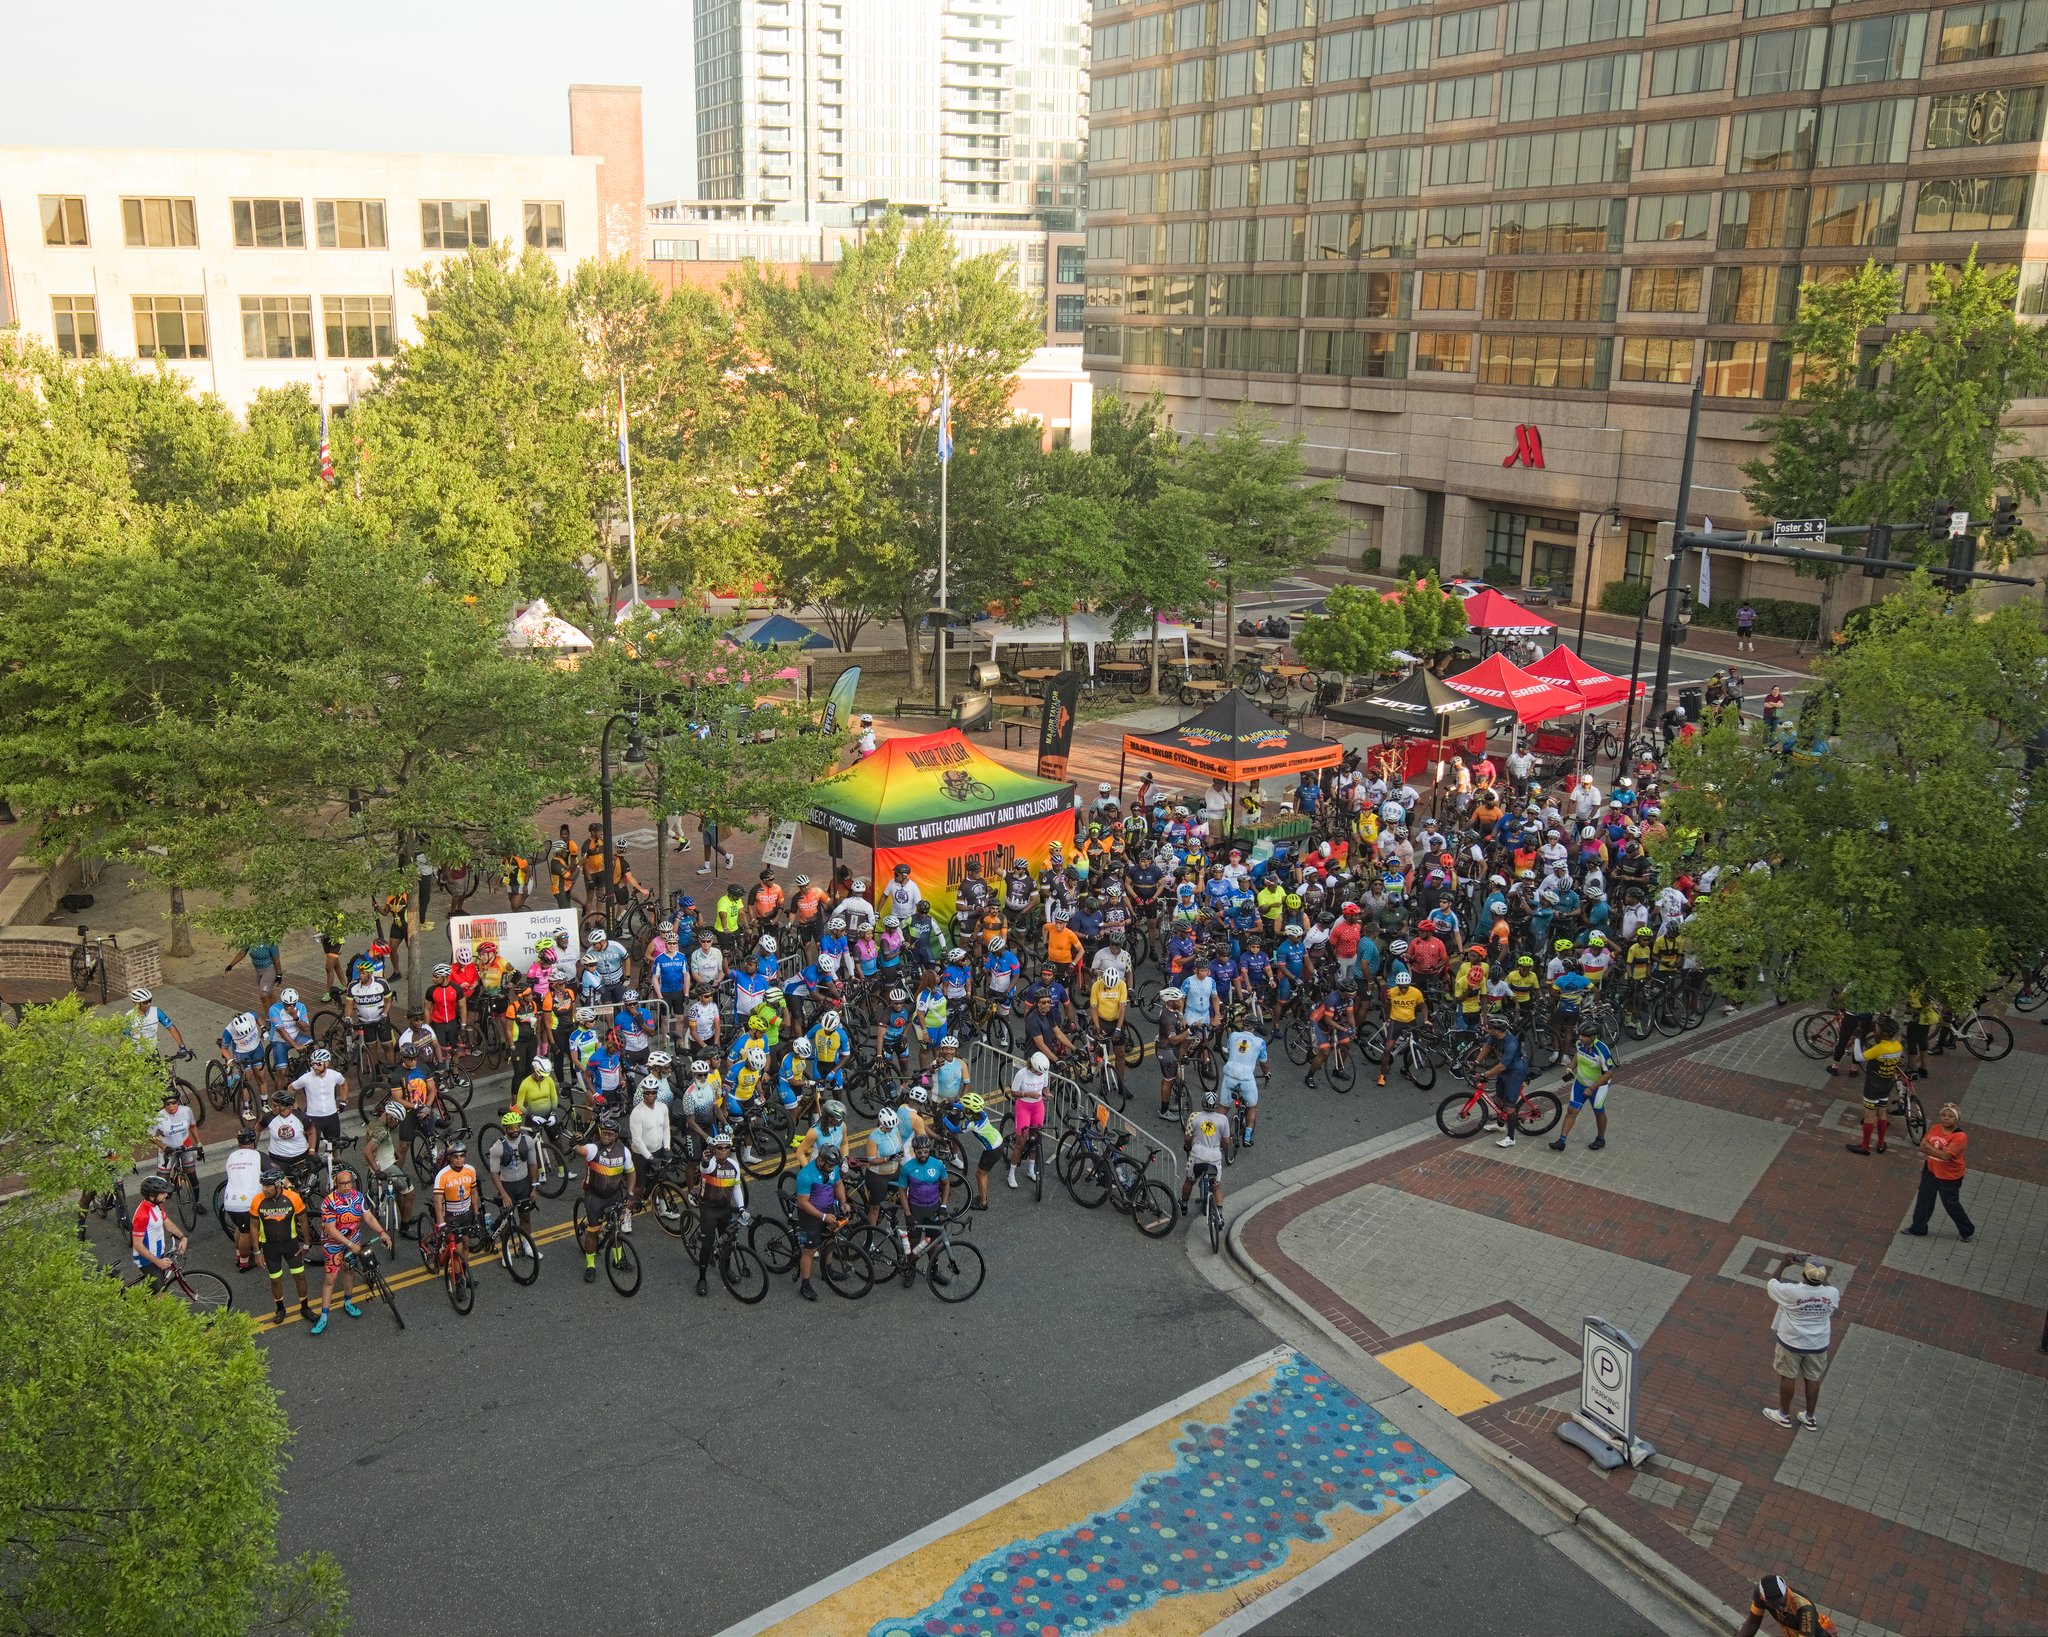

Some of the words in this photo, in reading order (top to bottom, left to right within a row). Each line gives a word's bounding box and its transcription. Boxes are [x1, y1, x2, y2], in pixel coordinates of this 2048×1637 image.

[1776, 523, 1802, 533] Foster
[1803, 522, 1814, 532] St
[1488, 626, 1553, 636] TREK
[1576, 675, 1612, 687] SRAM
[1510, 683, 1553, 698] SRAM
[1366, 697, 1427, 711] ZIPP
[1434, 699, 1471, 714] ZIPP
[823, 703, 836, 734] TAYLOR
[1046, 719, 1054, 744] MAJOR
[1050, 690, 1059, 718] TAYLOR
[1178, 726, 1204, 734] MAJOR
[1204, 728, 1233, 742] TAYLOR
[1237, 731, 1265, 743] MAJOR
[1263, 729, 1291, 737] TAYLOR
[1407, 726, 1434, 734] ZIPP
[905, 749, 942, 769] MAJOR
[934, 742, 971, 766] TAYLOR
[1130, 741, 1151, 754] MAJOR
[1152, 748, 1173, 760] TAYLOR
[1174, 752, 1198, 767] CYCLING
[1258, 765, 1269, 773] WITH
[897, 826, 919, 842] RIDE
[920, 821, 943, 839] WITH
[944, 811, 995, 834] COMMUNITY
[997, 808, 1015, 823] AND
[1016, 796, 1059, 819] INCLUSION
[947, 853, 981, 886] MAJ
[983, 845, 1015, 878] TAYOR
[530, 915, 561, 925] Riding
[458, 923, 482, 940] MAJOR
[482, 921, 508, 938] TAYLOR
[525, 931, 537, 940] To
[522, 946, 536, 955] Th
[686, 1134, 694, 1157] MTCC
[445, 1175, 472, 1188] MAJOR
[1600, 1356, 1614, 1376] P
[1591, 1385, 1620, 1410] PARKING
